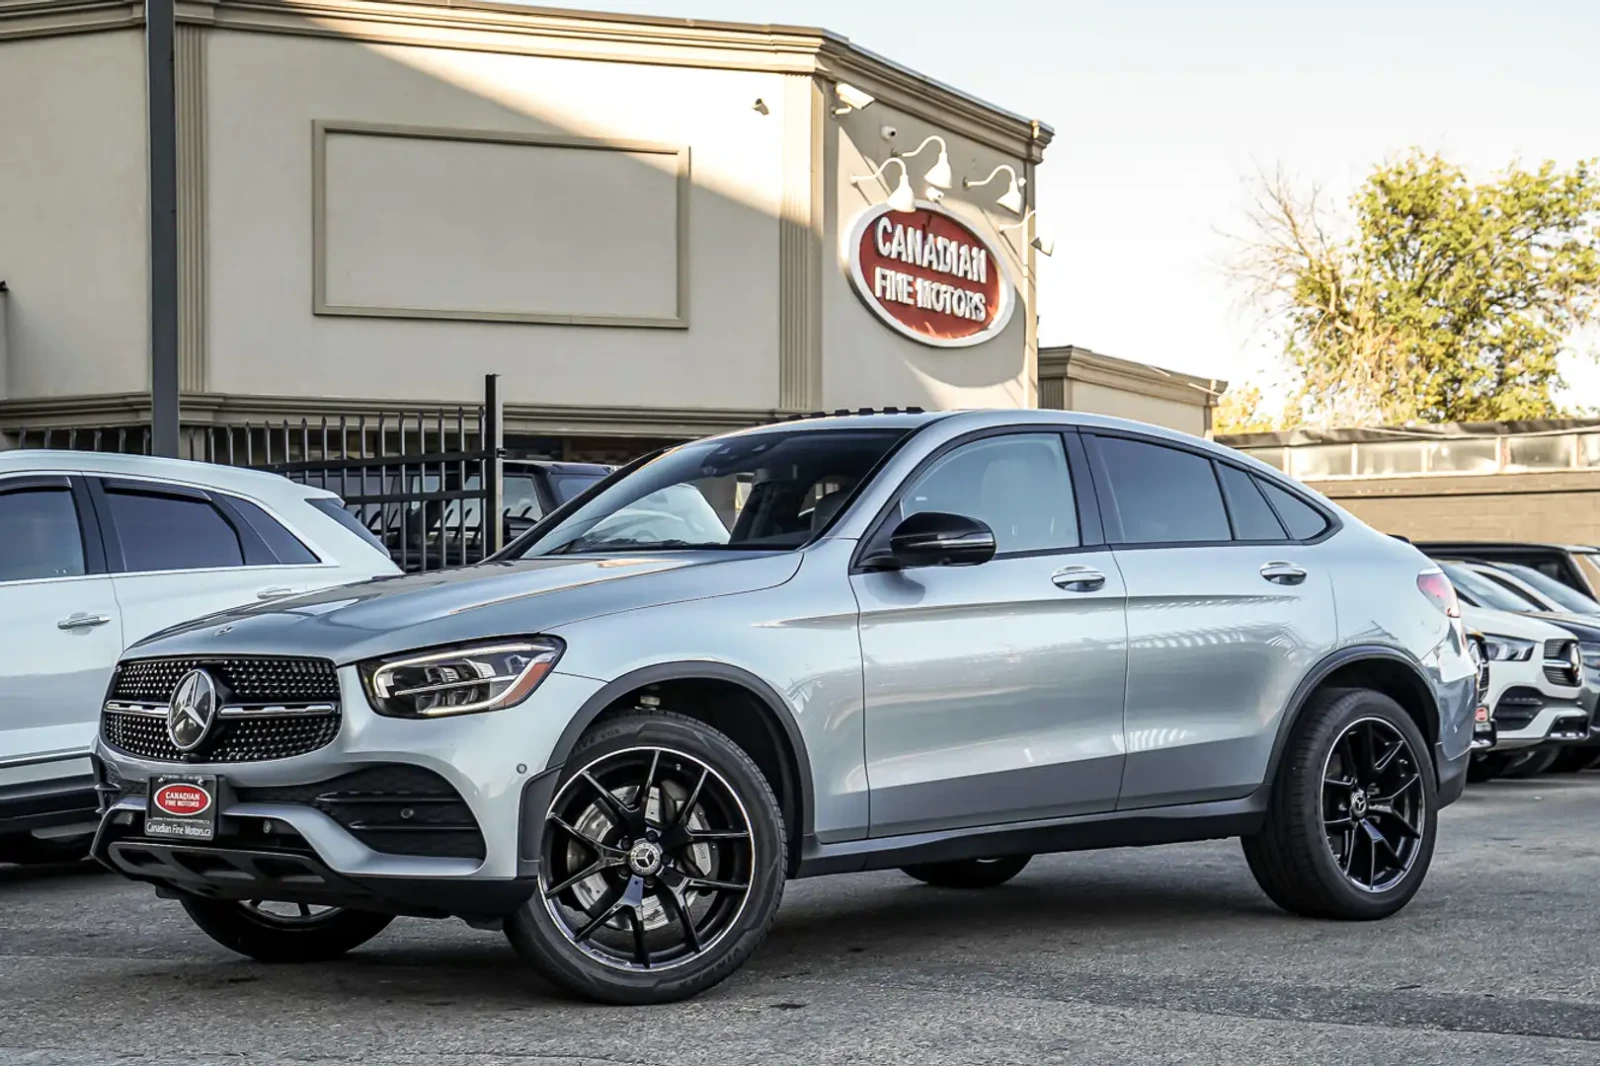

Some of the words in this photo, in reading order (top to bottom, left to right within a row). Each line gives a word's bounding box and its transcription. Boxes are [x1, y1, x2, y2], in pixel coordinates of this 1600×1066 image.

[877, 217, 987, 283] CANADIAN
[874, 266, 914, 305] FINE
[915, 277, 986, 322] MOTORS
[165, 791, 200, 801] CANADIAN
[146, 822, 172, 833] Canadian
[172, 824, 184, 835] Fine
